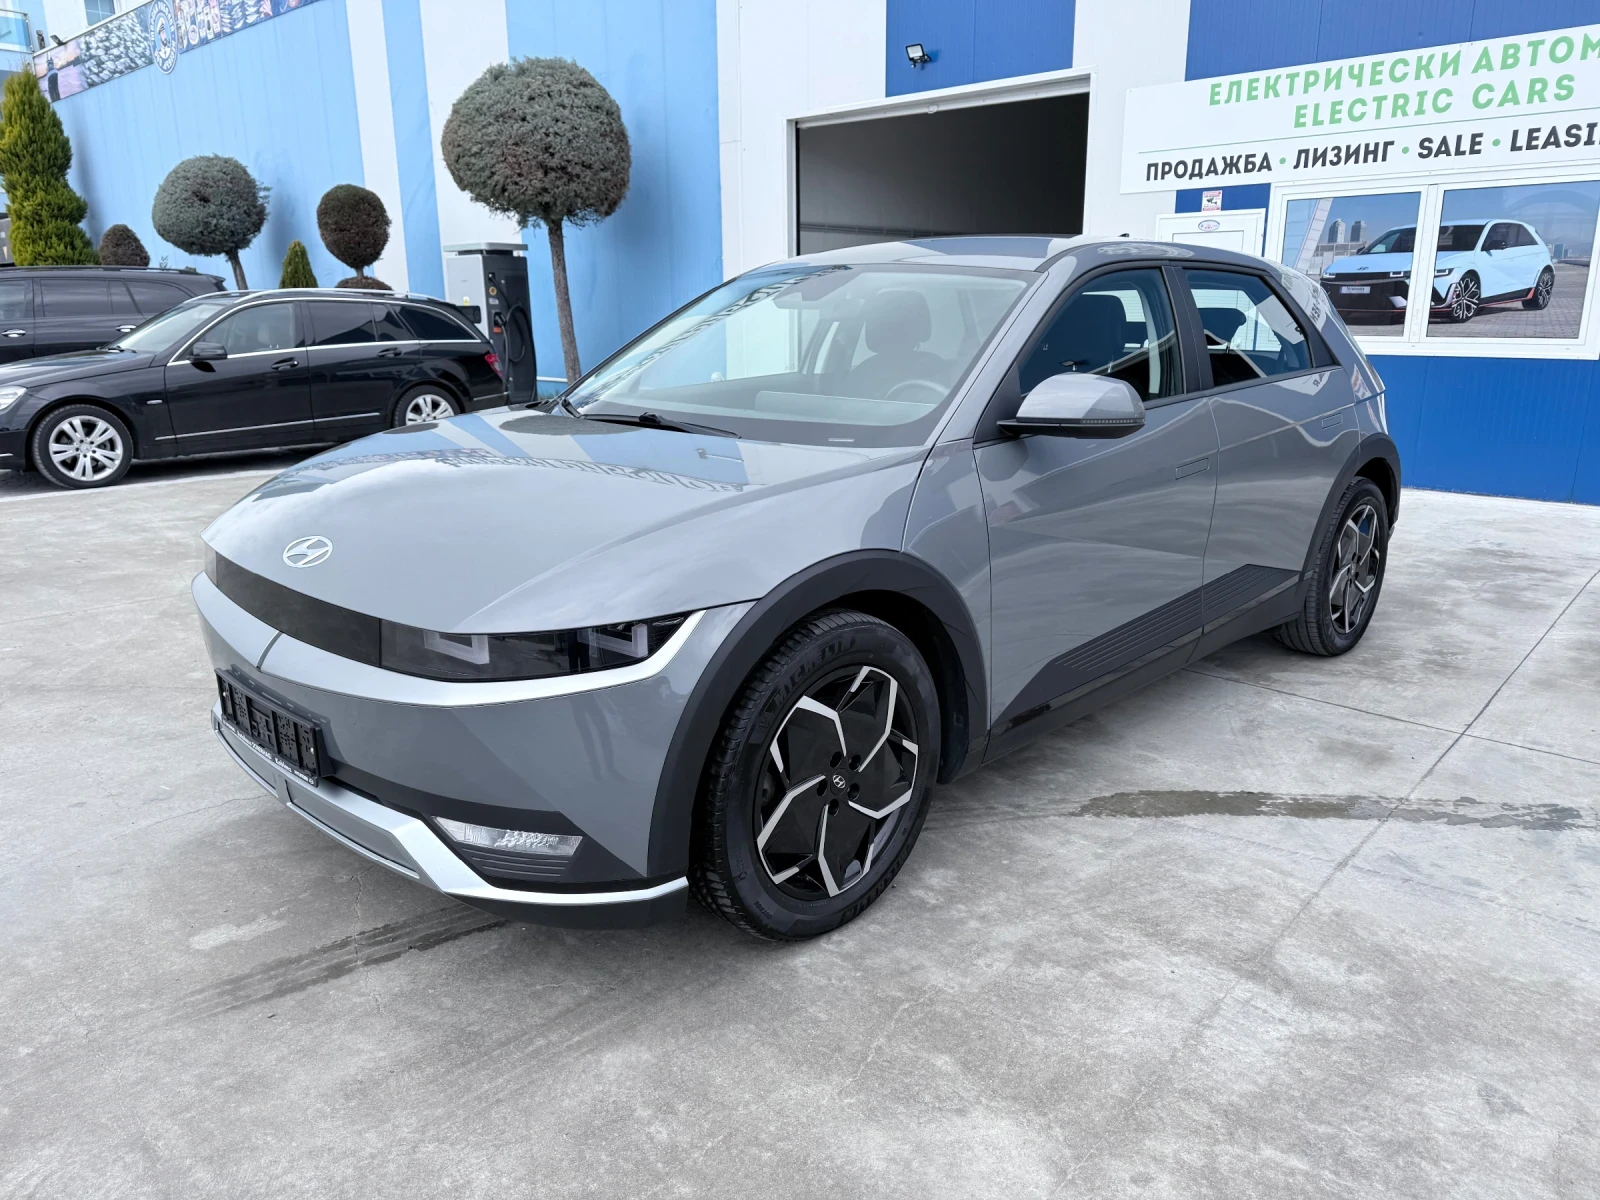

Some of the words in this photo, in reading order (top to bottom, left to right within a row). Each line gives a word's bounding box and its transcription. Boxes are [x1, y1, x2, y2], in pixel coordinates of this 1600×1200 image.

[1209, 52, 1461, 106] ЕЛЕКТРИЧЕСКИ
[1472, 33, 1600, 73] АВТОМ
[1294, 88, 1453, 129] ELECTRIC
[1471, 73, 1575, 110] CARS
[1146, 153, 1273, 182] ПРОДАЖБА
[1293, 140, 1395, 170] ЛИЗИНГ
[1417, 132, 1484, 159] SALE
[1510, 122, 1600, 152] LEASI
